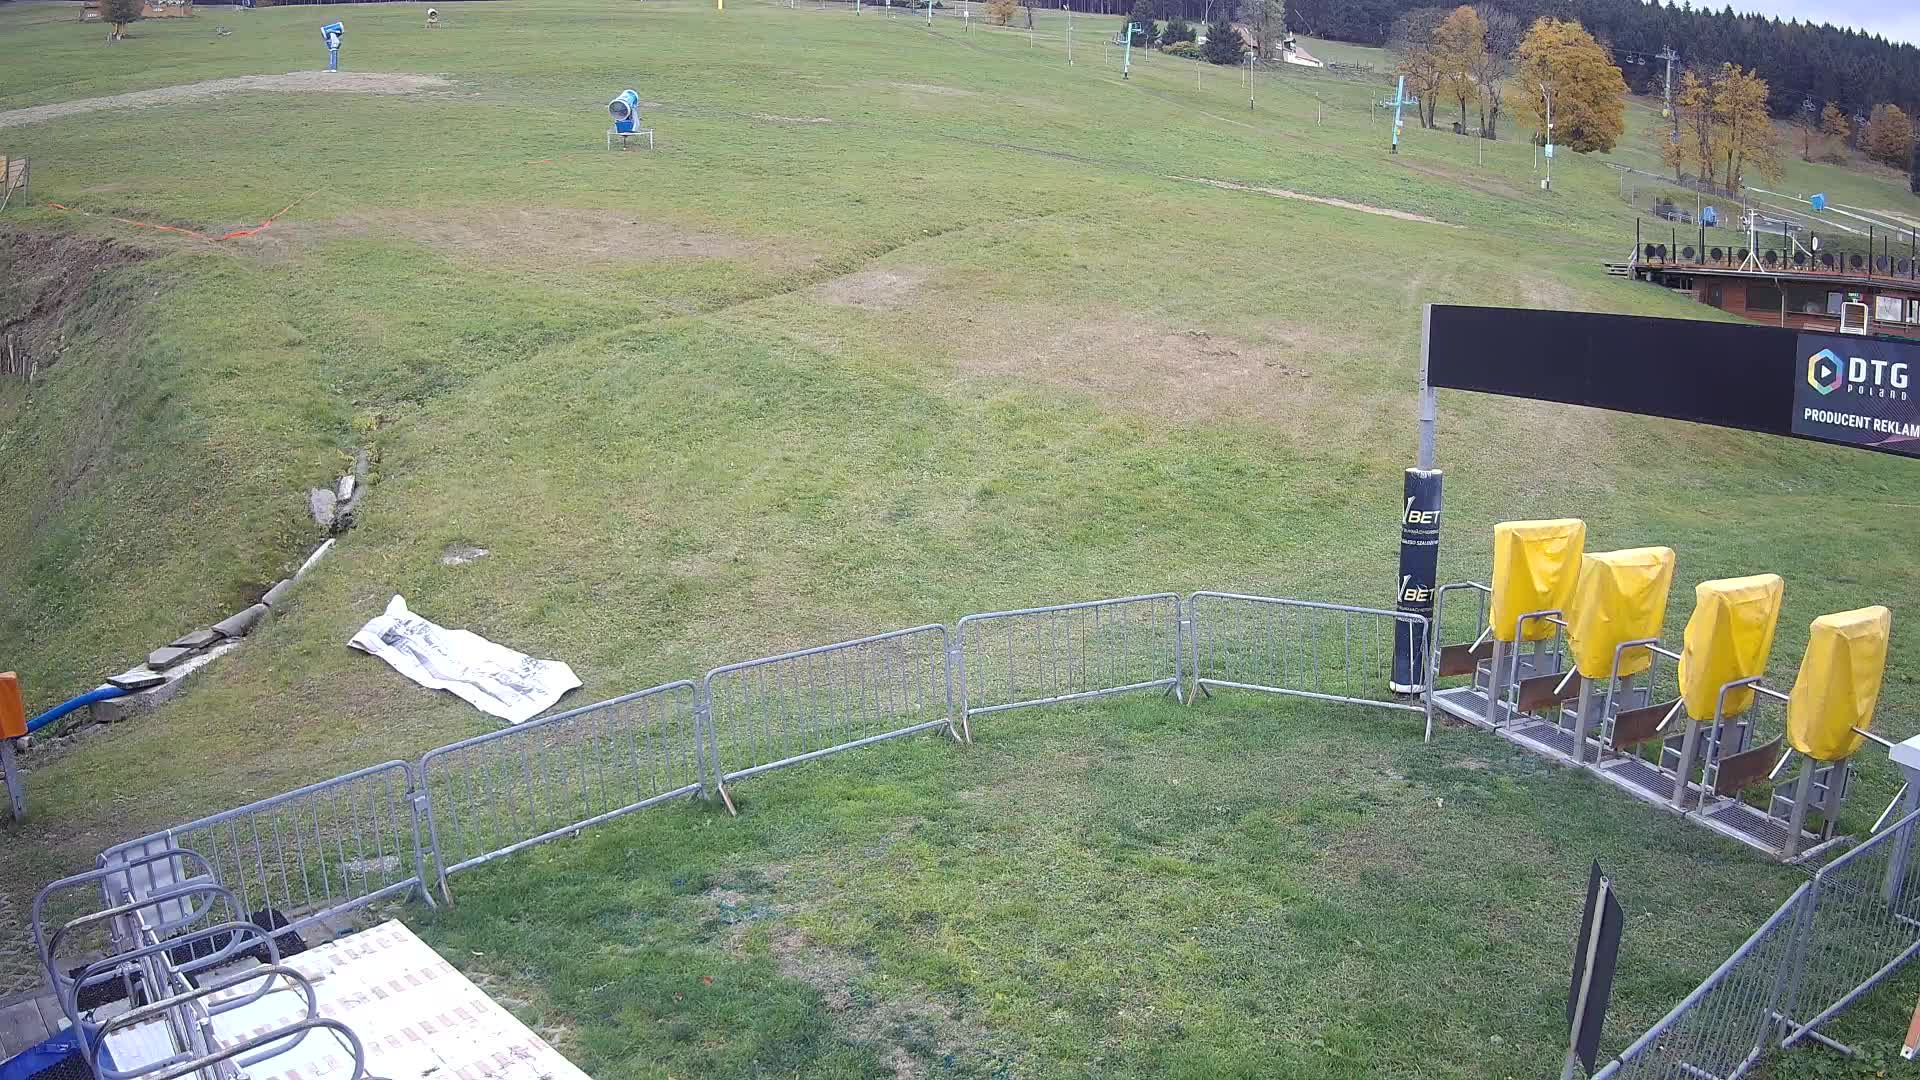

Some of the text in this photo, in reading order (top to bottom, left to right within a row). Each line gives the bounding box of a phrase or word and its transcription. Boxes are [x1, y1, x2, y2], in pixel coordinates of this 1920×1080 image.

[1848, 357, 1908, 389] DTG
[1804, 407, 1920, 438] PRODUCENT REKLAM
